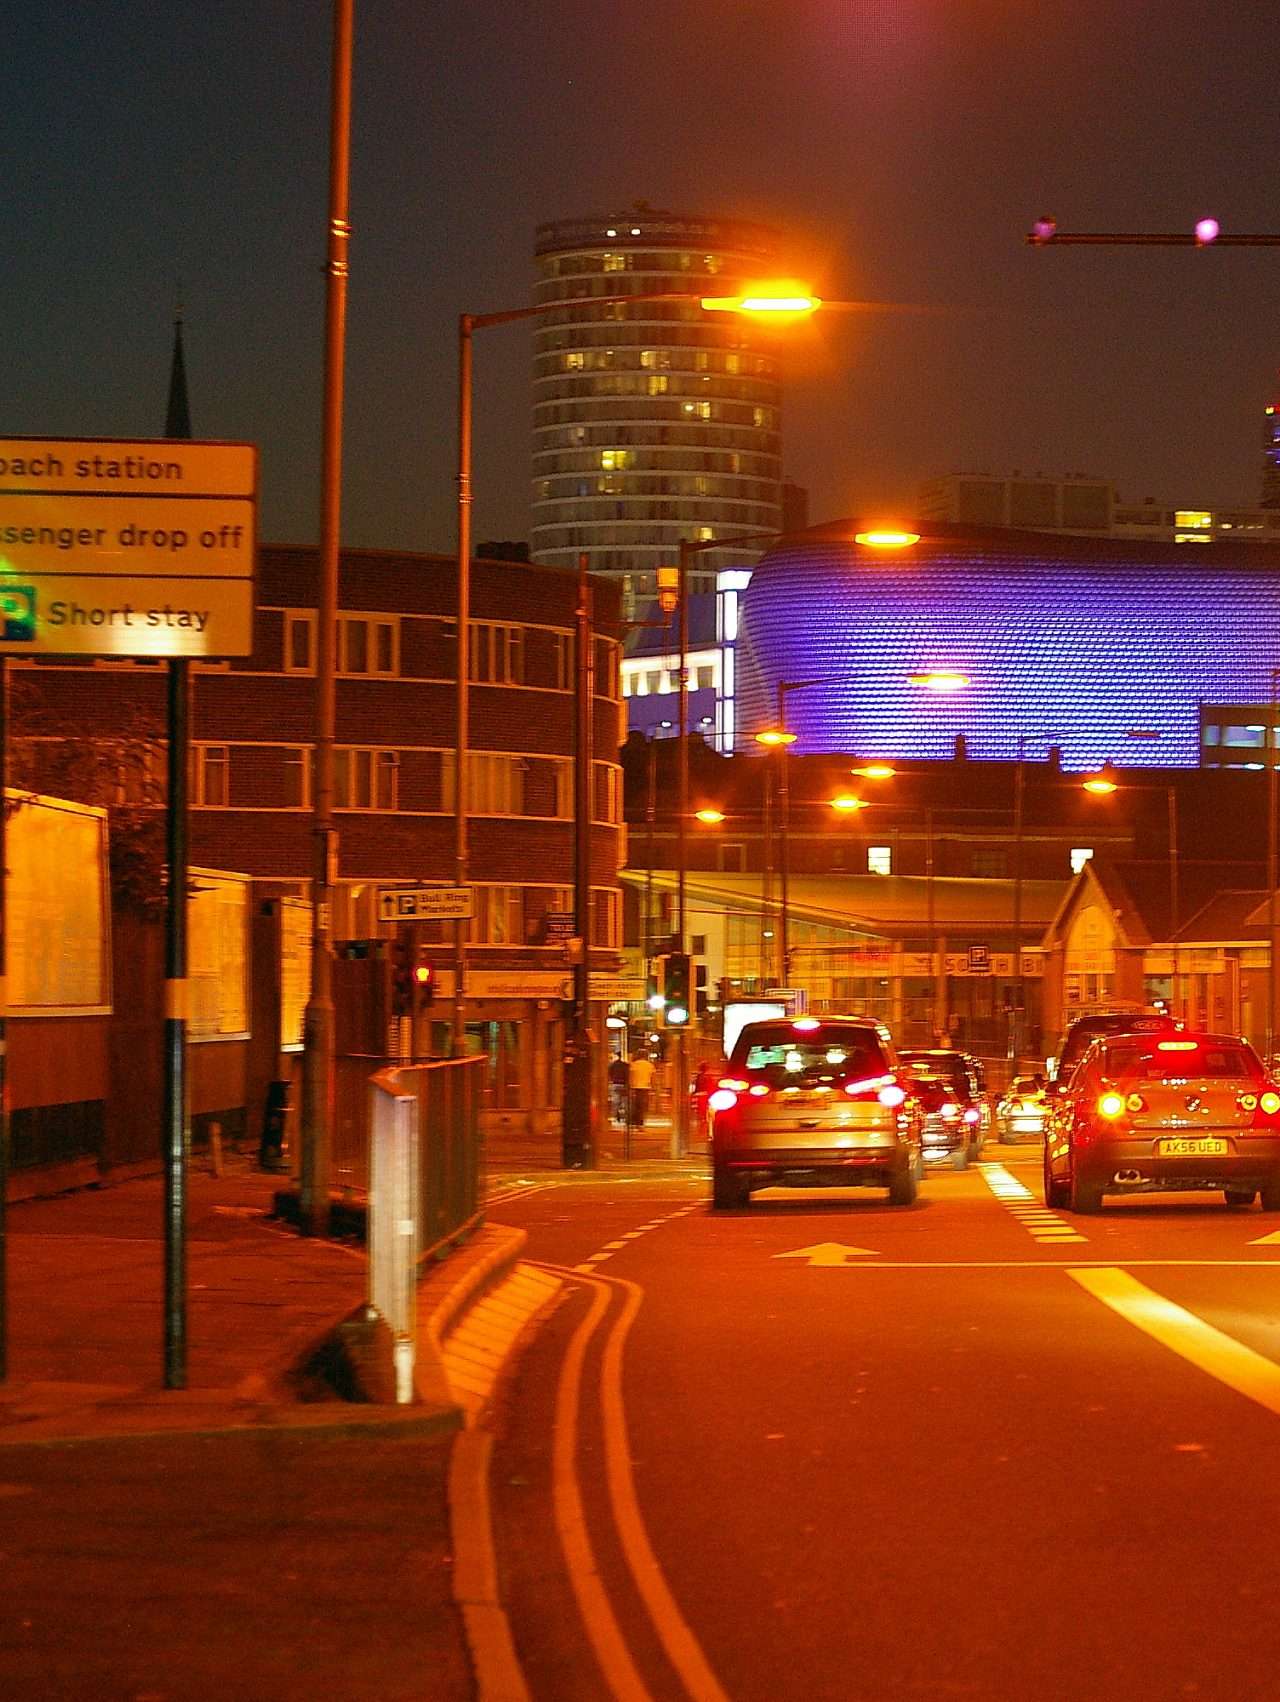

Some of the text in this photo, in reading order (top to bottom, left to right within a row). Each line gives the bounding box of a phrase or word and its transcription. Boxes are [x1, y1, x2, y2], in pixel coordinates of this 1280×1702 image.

[75, 455, 183, 479] station
[0, 524, 243, 551] senger drop off
[48, 601, 134, 626] Short
[146, 604, 209, 632] stay
